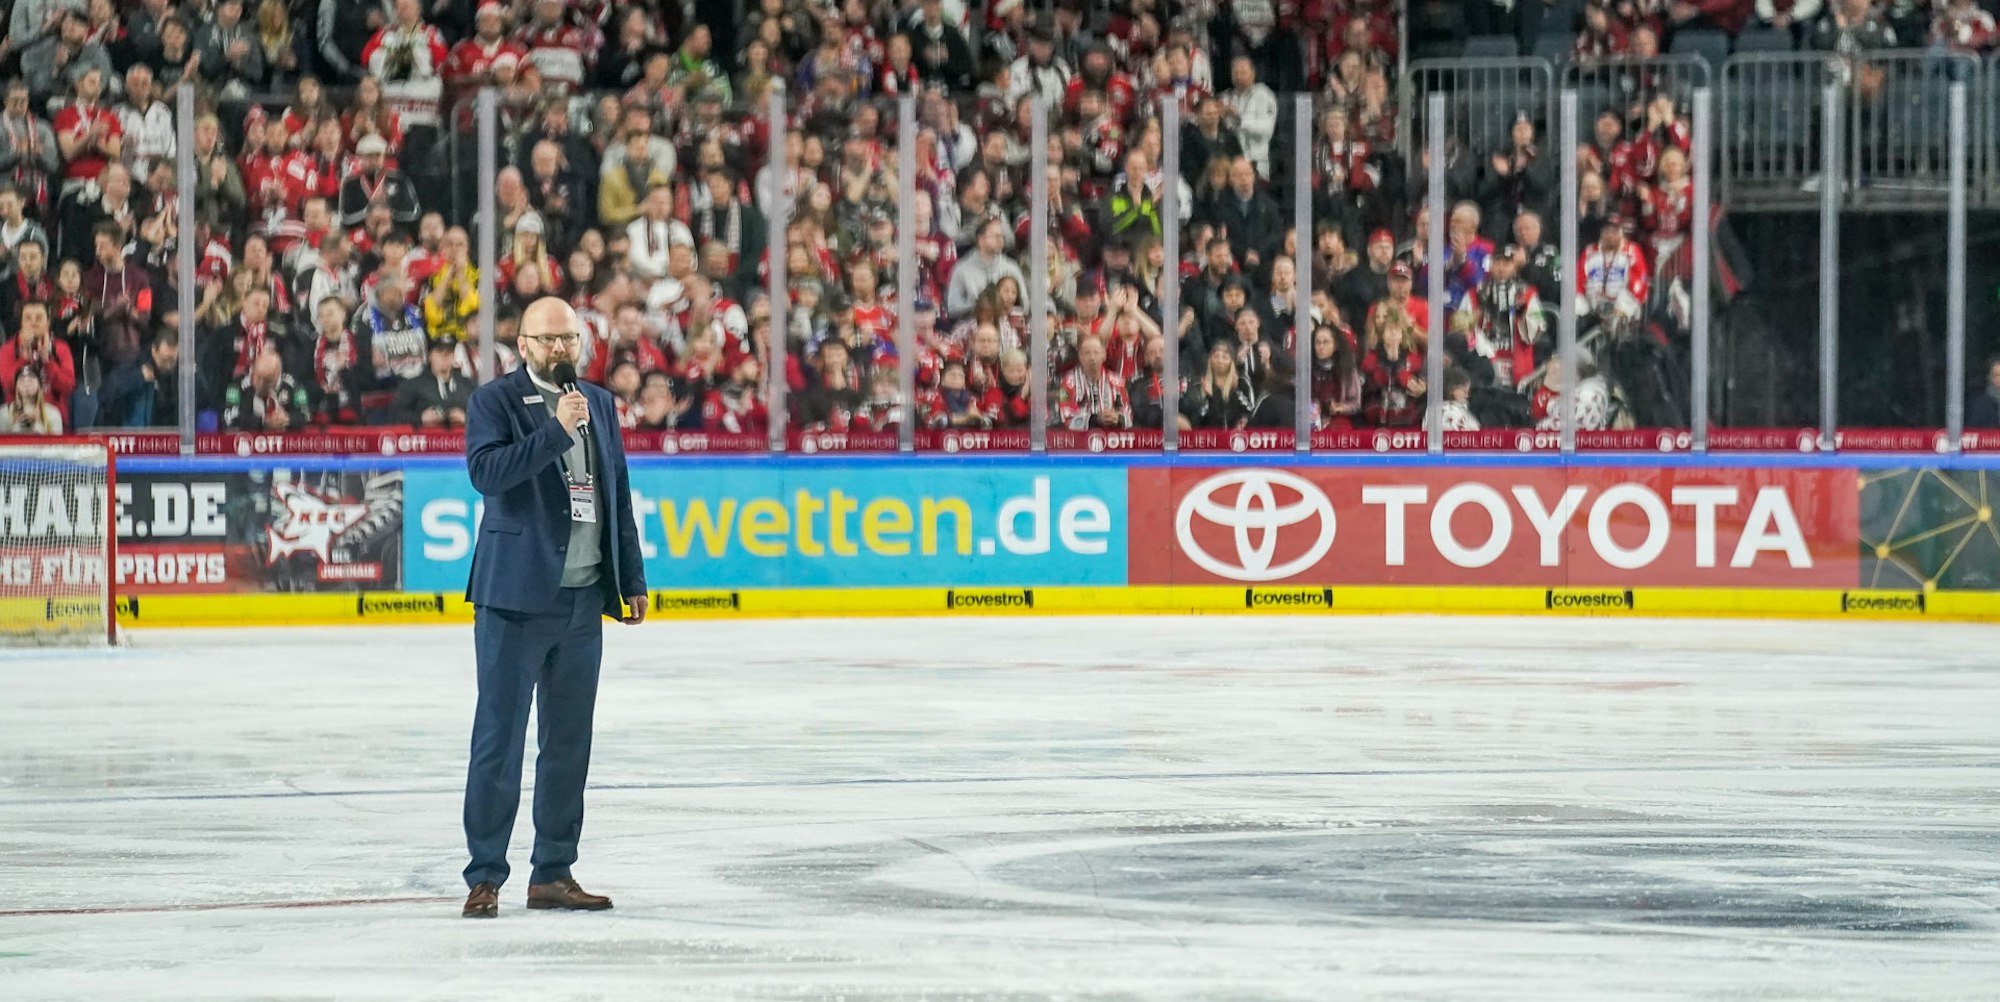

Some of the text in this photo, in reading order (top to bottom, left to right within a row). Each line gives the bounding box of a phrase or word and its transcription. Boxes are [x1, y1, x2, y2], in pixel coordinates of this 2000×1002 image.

[254, 435, 366, 453] OTT IMMOBILIEN
[398, 435, 427, 452] OTT
[818, 433, 848, 450] OTT
[962, 432, 990, 449] OTT
[1107, 432, 1135, 449] OTT
[1249, 432, 1277, 449] OTT
[1392, 432, 1420, 449] OTT
[1362, 483, 1813, 570] TOYOTA
[116, 552, 226, 584] PROFIS
[954, 592, 1024, 606] covestro
[1253, 591, 1323, 605] covestro
[1552, 593, 1623, 607] covestro
